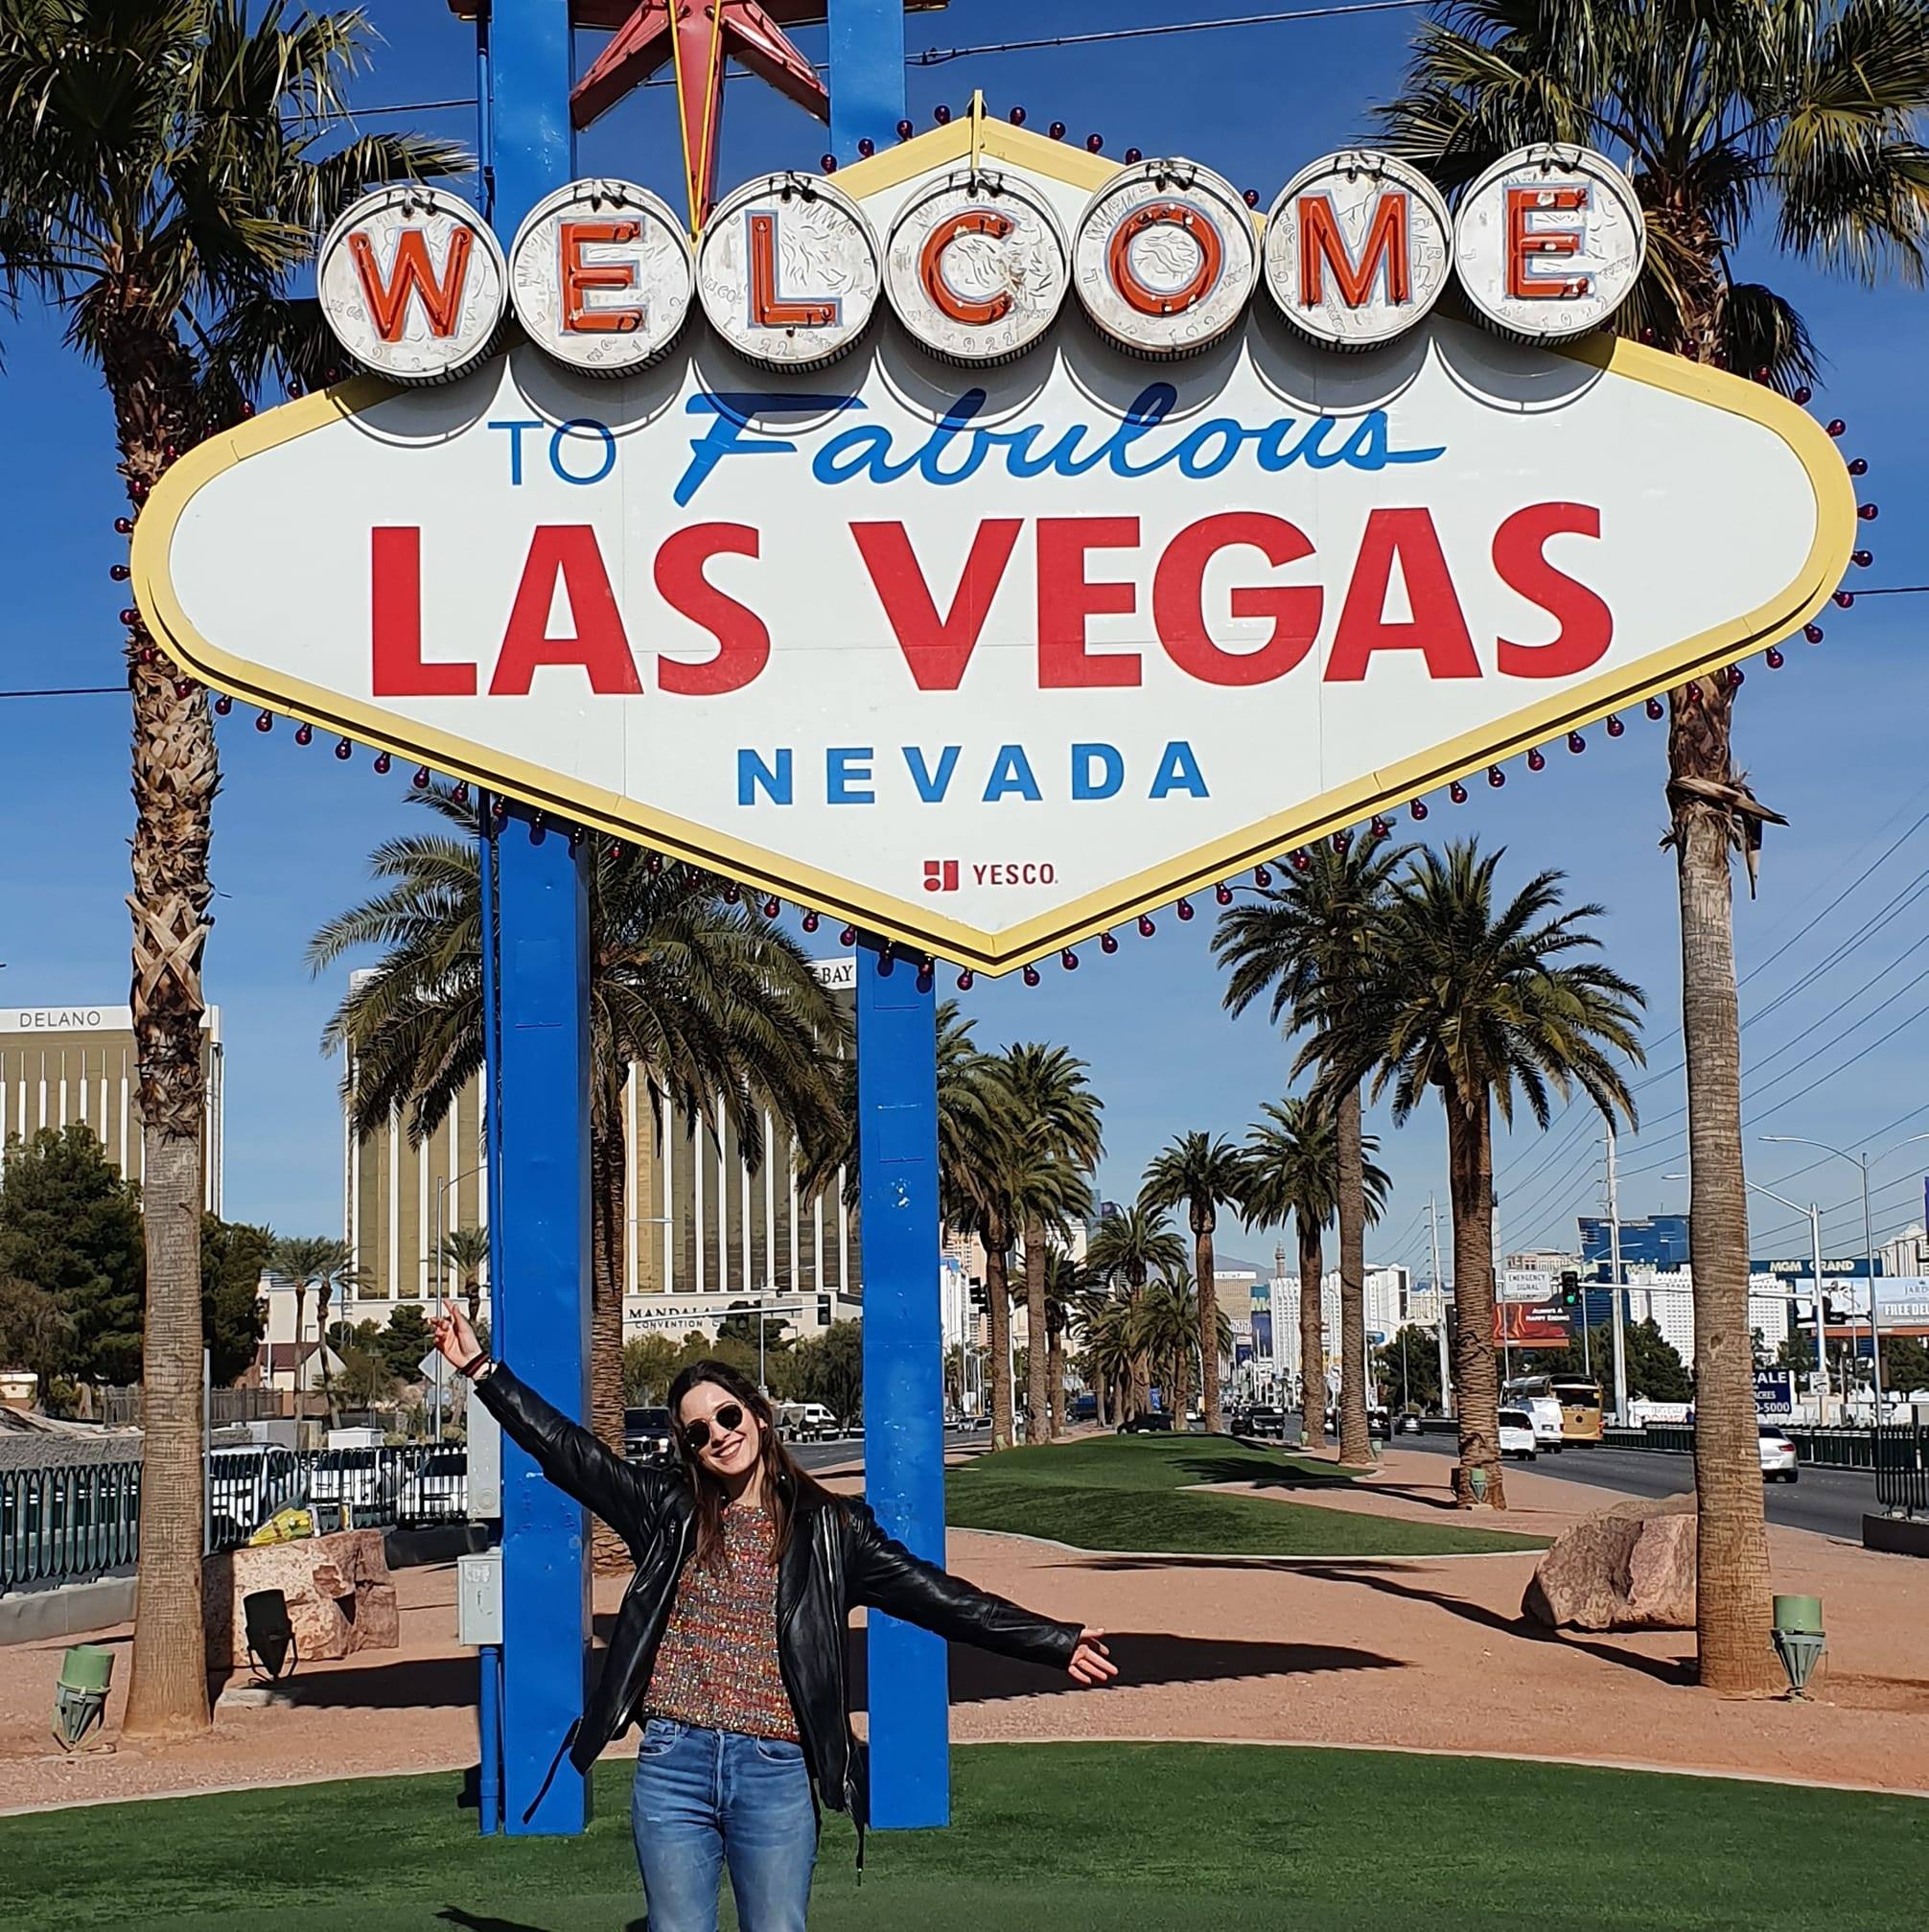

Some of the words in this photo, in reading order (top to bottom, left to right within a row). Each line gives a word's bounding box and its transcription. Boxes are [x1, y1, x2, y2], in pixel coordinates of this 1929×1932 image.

[346, 188, 1589, 343] WELCOME
[487, 419, 616, 486] TO
[673, 383, 1446, 507] Fabulous
[370, 522, 771, 697] LAS
[848, 500, 1614, 692] VEGAS
[736, 740, 1211, 806] NEVADA
[972, 863, 1056, 885] YESCO
[822, 965, 853, 985] BAY
[19, 1011, 102, 1029] DELANO
[1770, 1261, 1802, 1273] MGM
[635, 1320, 703, 1330] CONVENTION
